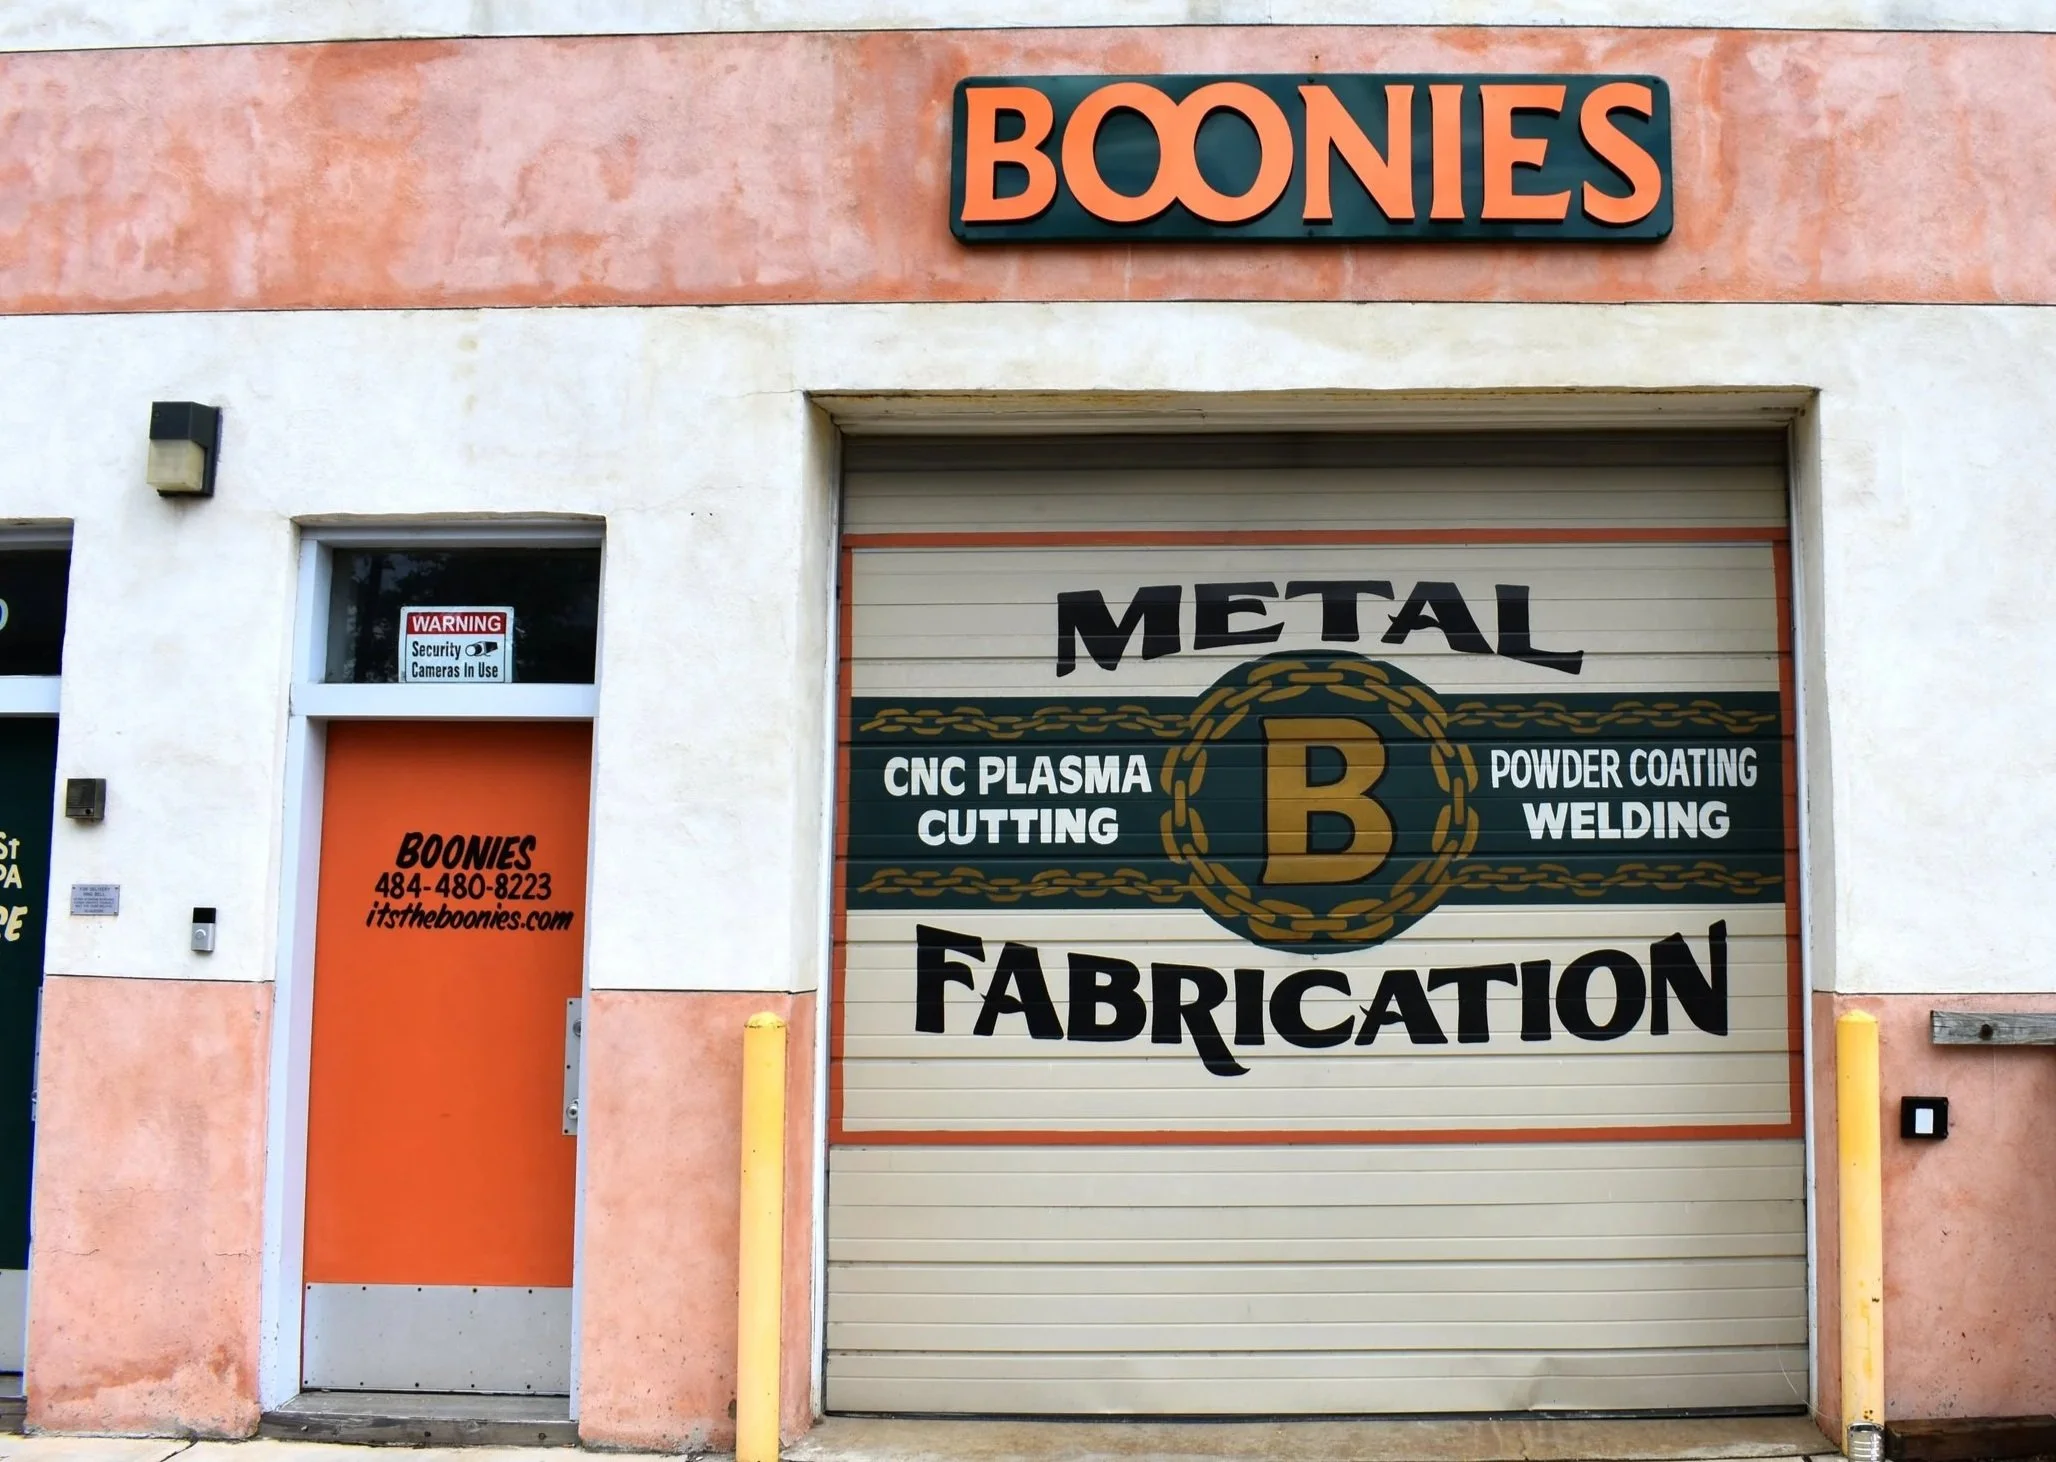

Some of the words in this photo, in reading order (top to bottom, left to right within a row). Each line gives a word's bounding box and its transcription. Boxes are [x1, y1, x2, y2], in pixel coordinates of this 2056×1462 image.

[960, 82, 1662, 223] BOONIES
[412, 615, 501, 632] WARNING
[1055, 580, 1585, 678] METAL
[411, 641, 461, 660] Security
[411, 661, 460, 678] Cameras
[464, 662, 475, 678] In
[478, 662, 499, 678] Use
[884, 756, 966, 797] CNC
[979, 754, 1152, 795] PLASMA
[1491, 748, 1624, 789] POWDER
[1629, 747, 1758, 787] COATING
[1262, 716, 1395, 885] B
[1522, 800, 1731, 840] WELDING
[918, 807, 1119, 846] CUTTING
[395, 831, 537, 871] BOONIES
[374, 872, 552, 900] 484-480-8223
[366, 901, 574, 931] itstheboonies.com
[915, 919, 1729, 1077] FABRICATION
